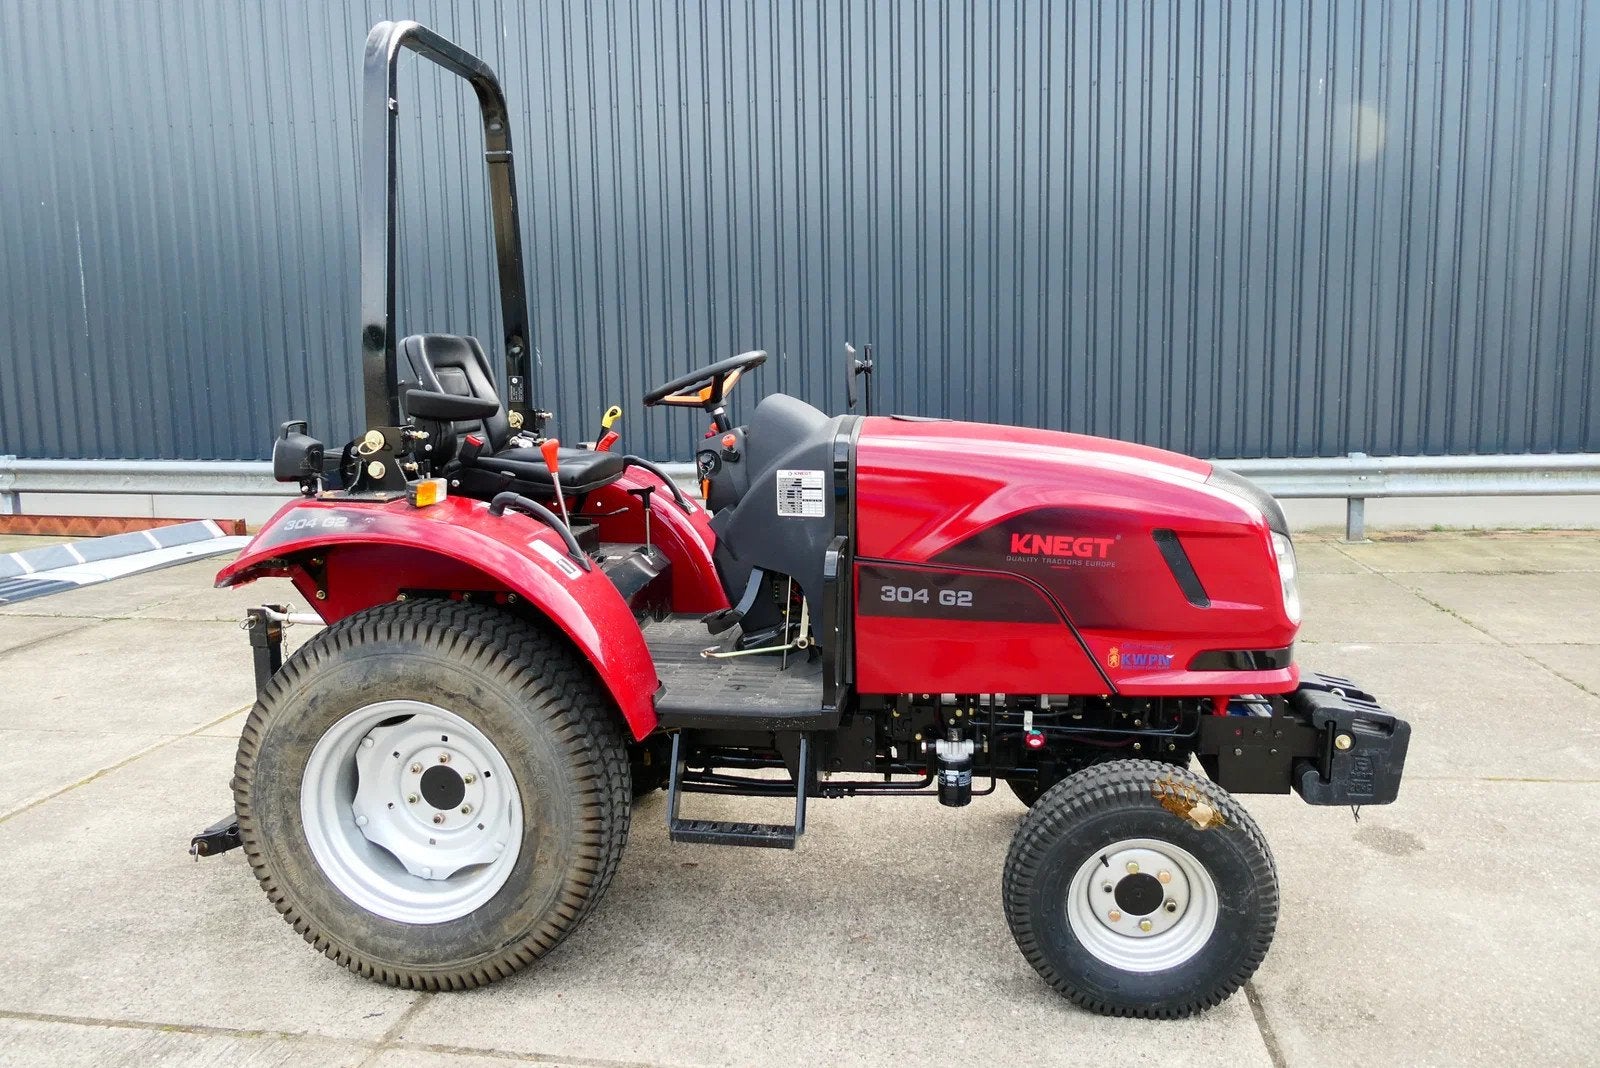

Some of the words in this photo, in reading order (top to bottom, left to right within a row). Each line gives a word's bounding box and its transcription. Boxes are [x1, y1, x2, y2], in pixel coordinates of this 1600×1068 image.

[283, 518, 317, 531] 304
[321, 516, 348, 528] G2
[1010, 533, 1115, 559] KNEGT
[1006, 555, 1039, 563] QUALITY
[1042, 556, 1082, 566] TRACTORS
[1085, 559, 1116, 568] EUROPE
[880, 585, 930, 604] 304
[938, 589, 973, 607] G2
[1121, 653, 1171, 666] KWPN
